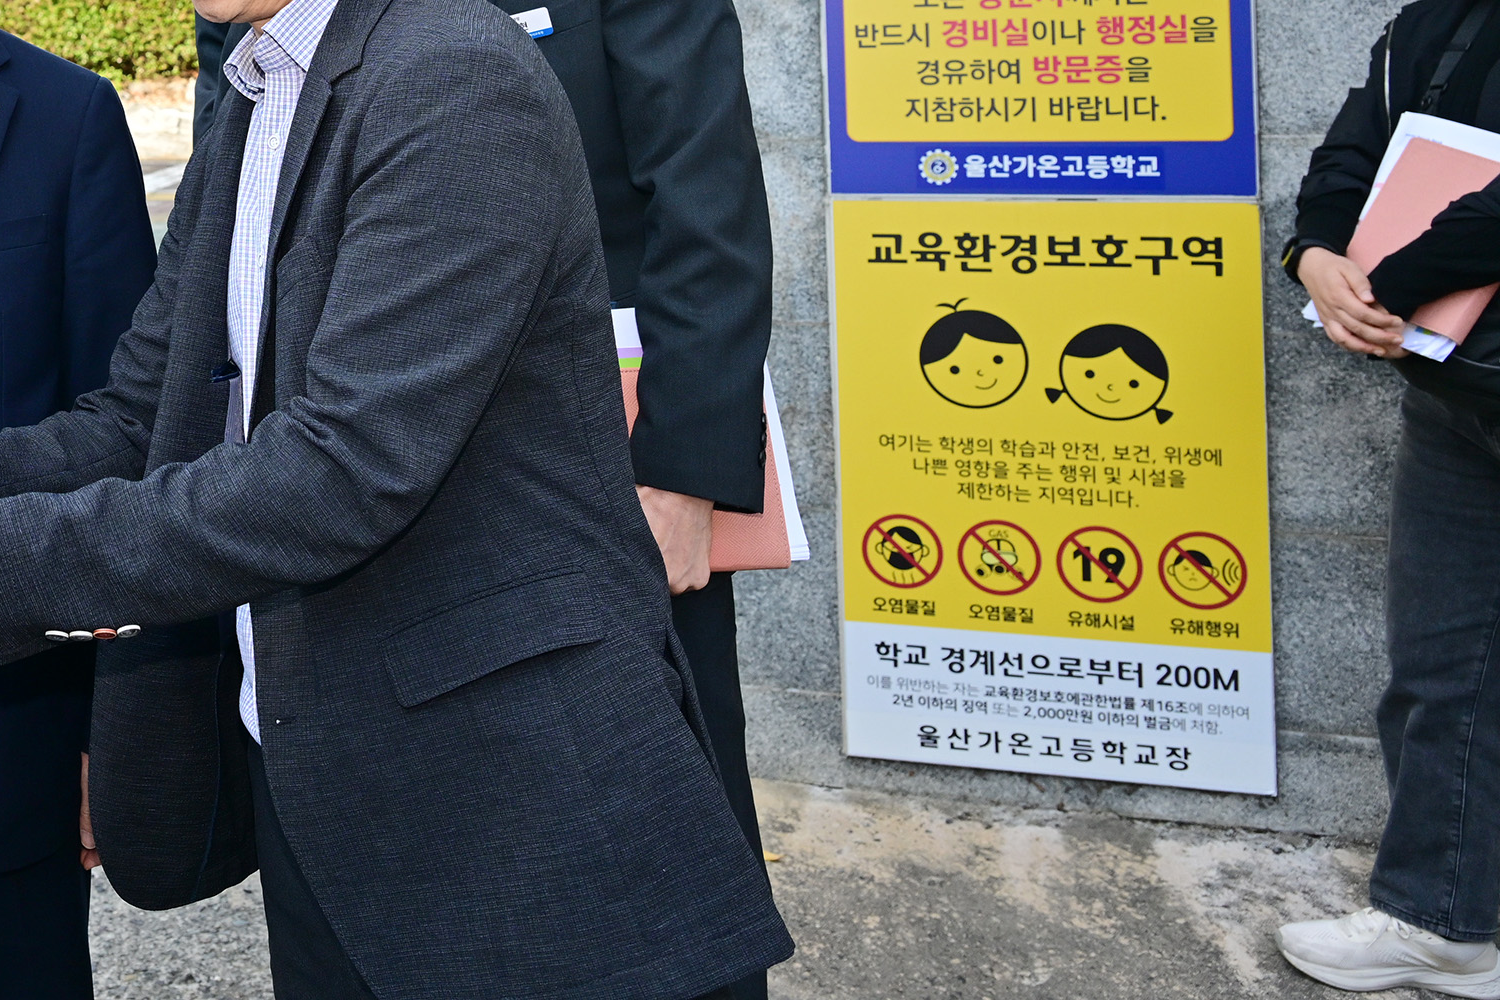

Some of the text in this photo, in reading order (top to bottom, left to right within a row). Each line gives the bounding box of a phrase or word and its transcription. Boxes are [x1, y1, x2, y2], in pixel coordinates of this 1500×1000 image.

[854, 14, 1219, 49] 반드시 경비실이나 행정실을
[916, 55, 1153, 86] 경유하여 방문증을
[904, 94, 1168, 124] 지참하시기 바랍니다.
[963, 154, 1161, 179] 울산가온고등학교
[867, 231, 1225, 277] 교육환경보호구역
[878, 433, 1223, 468] 여기는 학생의 학습과 안전, 보건, 위생에
[912, 457, 1187, 489] 나쁜 영향을 주는 행위 및 시설을
[956, 482, 1140, 510] 제한하는 지역입니다.
[1073, 546, 1126, 583] 19
[872, 596, 936, 617] 오염물질
[968, 603, 1034, 625] 오염물질
[1067, 610, 1136, 632] 유해시설
[1169, 617, 1241, 639] 유해행위
[874, 641, 1240, 693] 학교 경계선으로부터 200M
[866, 674, 893, 690] 이를
[896, 676, 950, 695] 위반하는
[892, 694, 914, 709] 2년
[917, 696, 958, 712] 이하의
[961, 699, 989, 715] 징역
[1023, 706, 1094, 725] 2,000만원
[1097, 711, 1140, 728] 이하의
[916, 724, 1193, 771] 울산가온고등학교장
